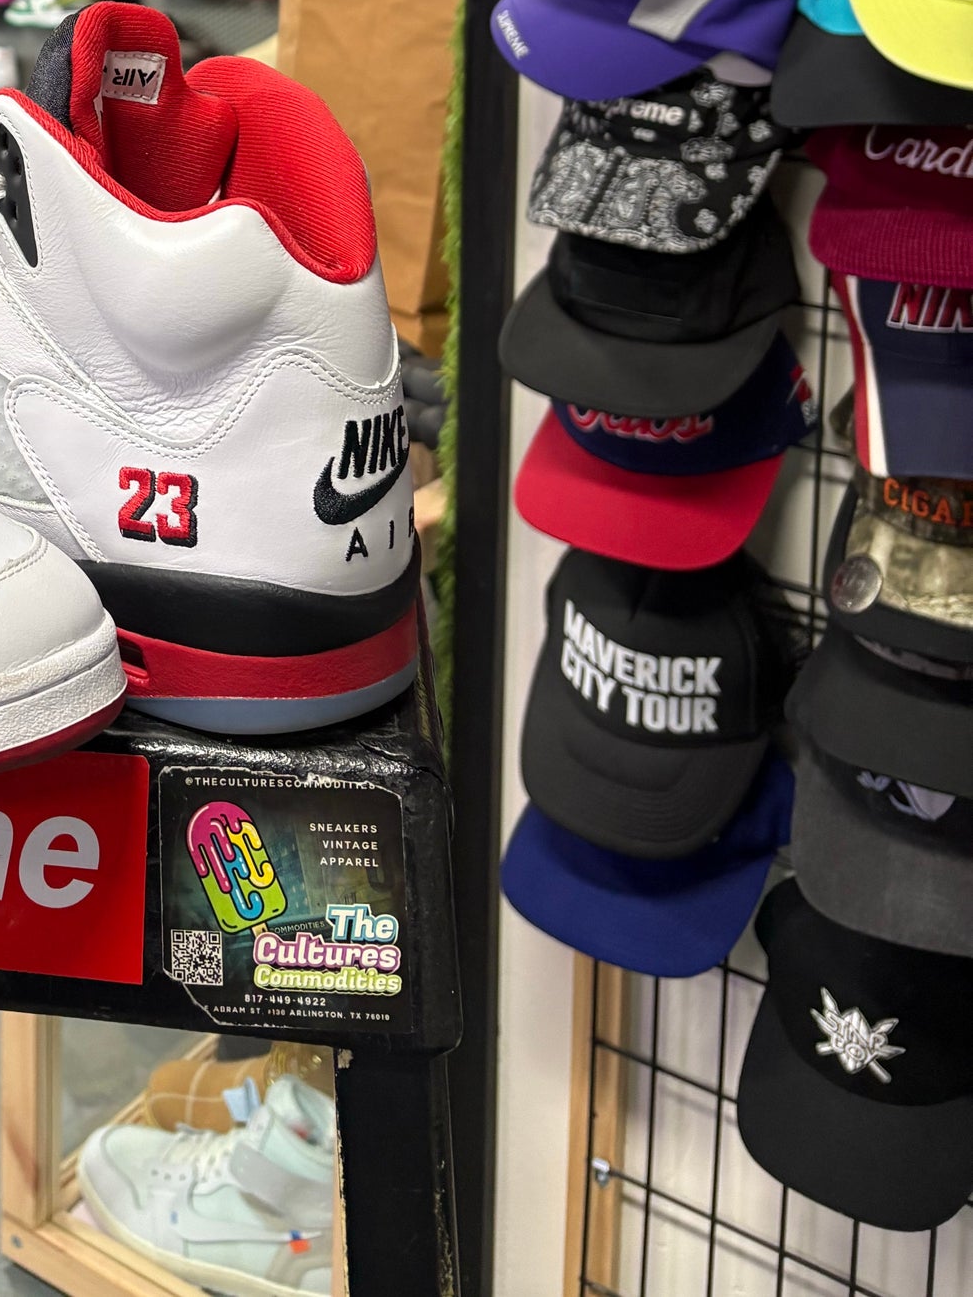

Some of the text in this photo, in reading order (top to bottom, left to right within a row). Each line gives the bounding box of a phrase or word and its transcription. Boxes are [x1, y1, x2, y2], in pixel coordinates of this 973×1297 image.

[497, 9, 529, 60] SUPREME
[112, 68, 157, 87] AIR
[337, 404, 410, 480] NIKE
[118, 466, 199, 548] 23
[563, 598, 723, 696] MAVERICK
[561, 638, 719, 735] CITY TOUR
[309, 823, 377, 834] SNEAKERS
[322, 840, 378, 851] VINTAGE
[320, 856, 378, 867] APPAREL
[270, 921, 325, 933] OMMODITIES
[329, 907, 395, 941] The
[255, 935, 398, 971] Cultures
[256, 967, 400, 992] Commodities
[244, 994, 326, 1006] 817-449-4922
[350, 1012, 362, 1020] TX
